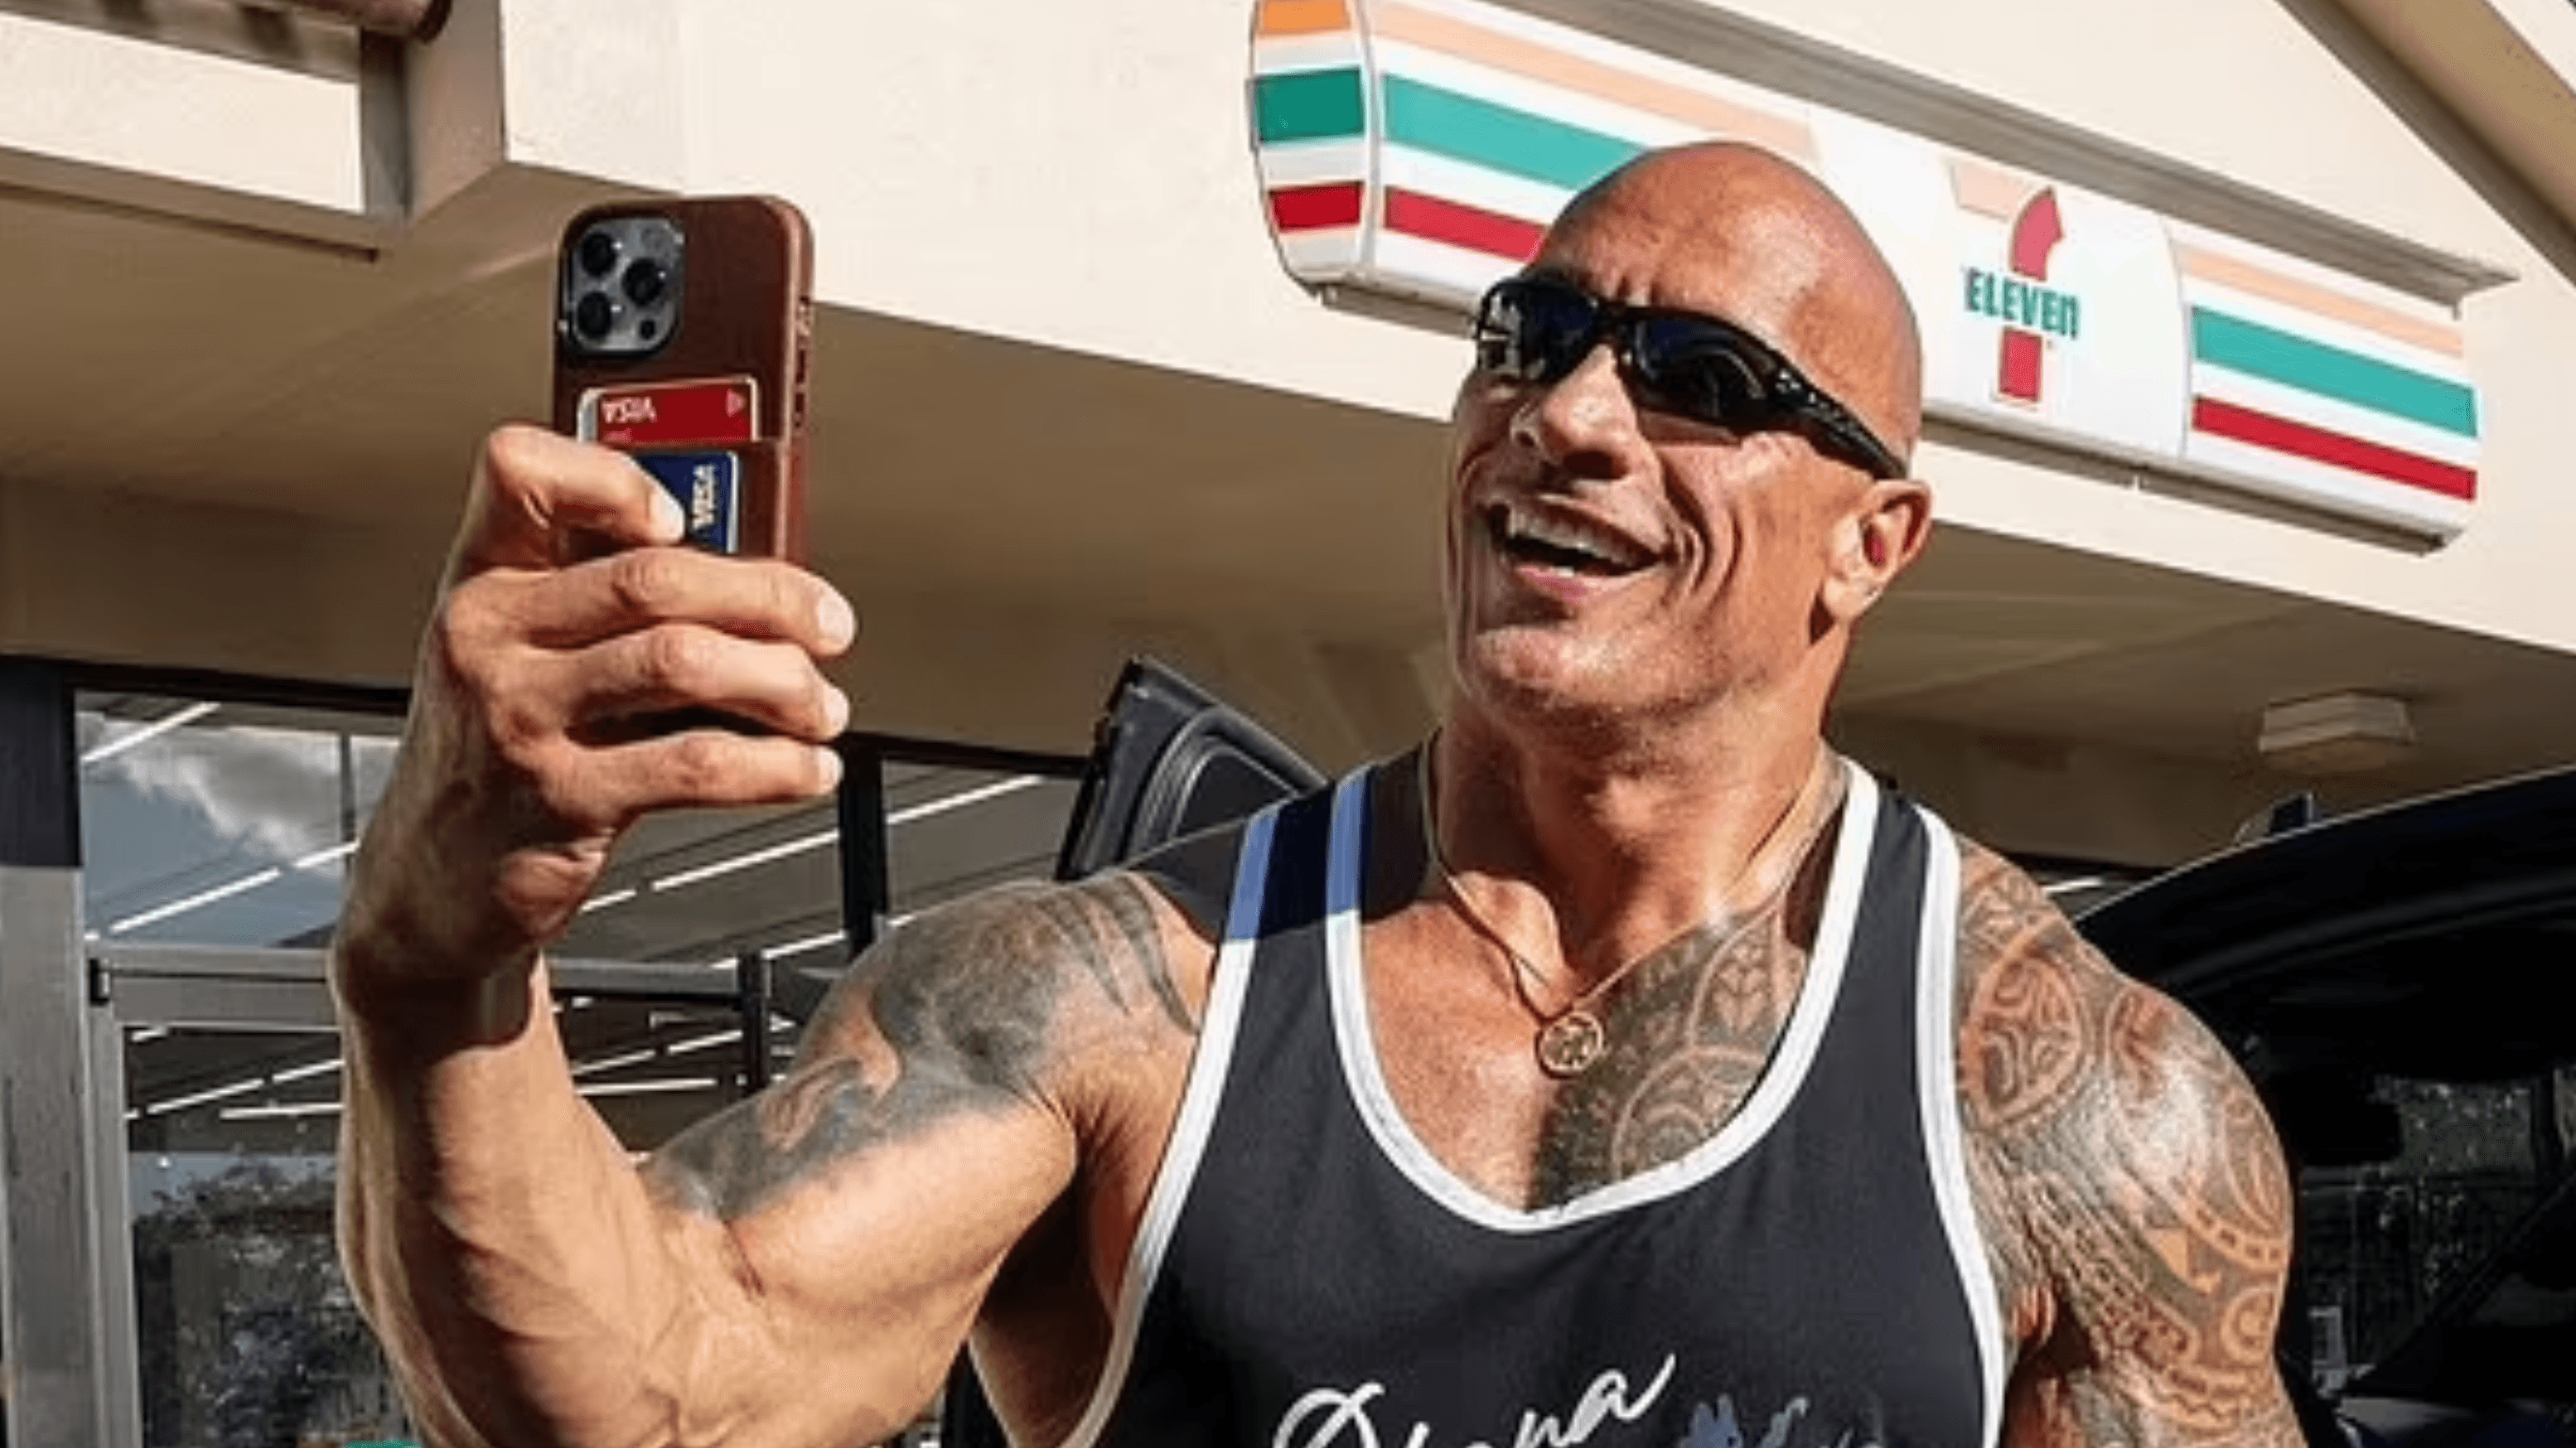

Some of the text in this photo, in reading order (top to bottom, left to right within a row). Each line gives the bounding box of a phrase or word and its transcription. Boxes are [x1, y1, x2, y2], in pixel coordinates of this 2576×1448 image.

[1950, 162, 2065, 404] 7
[601, 396, 656, 424] VISA
[691, 464, 717, 531] VISA
